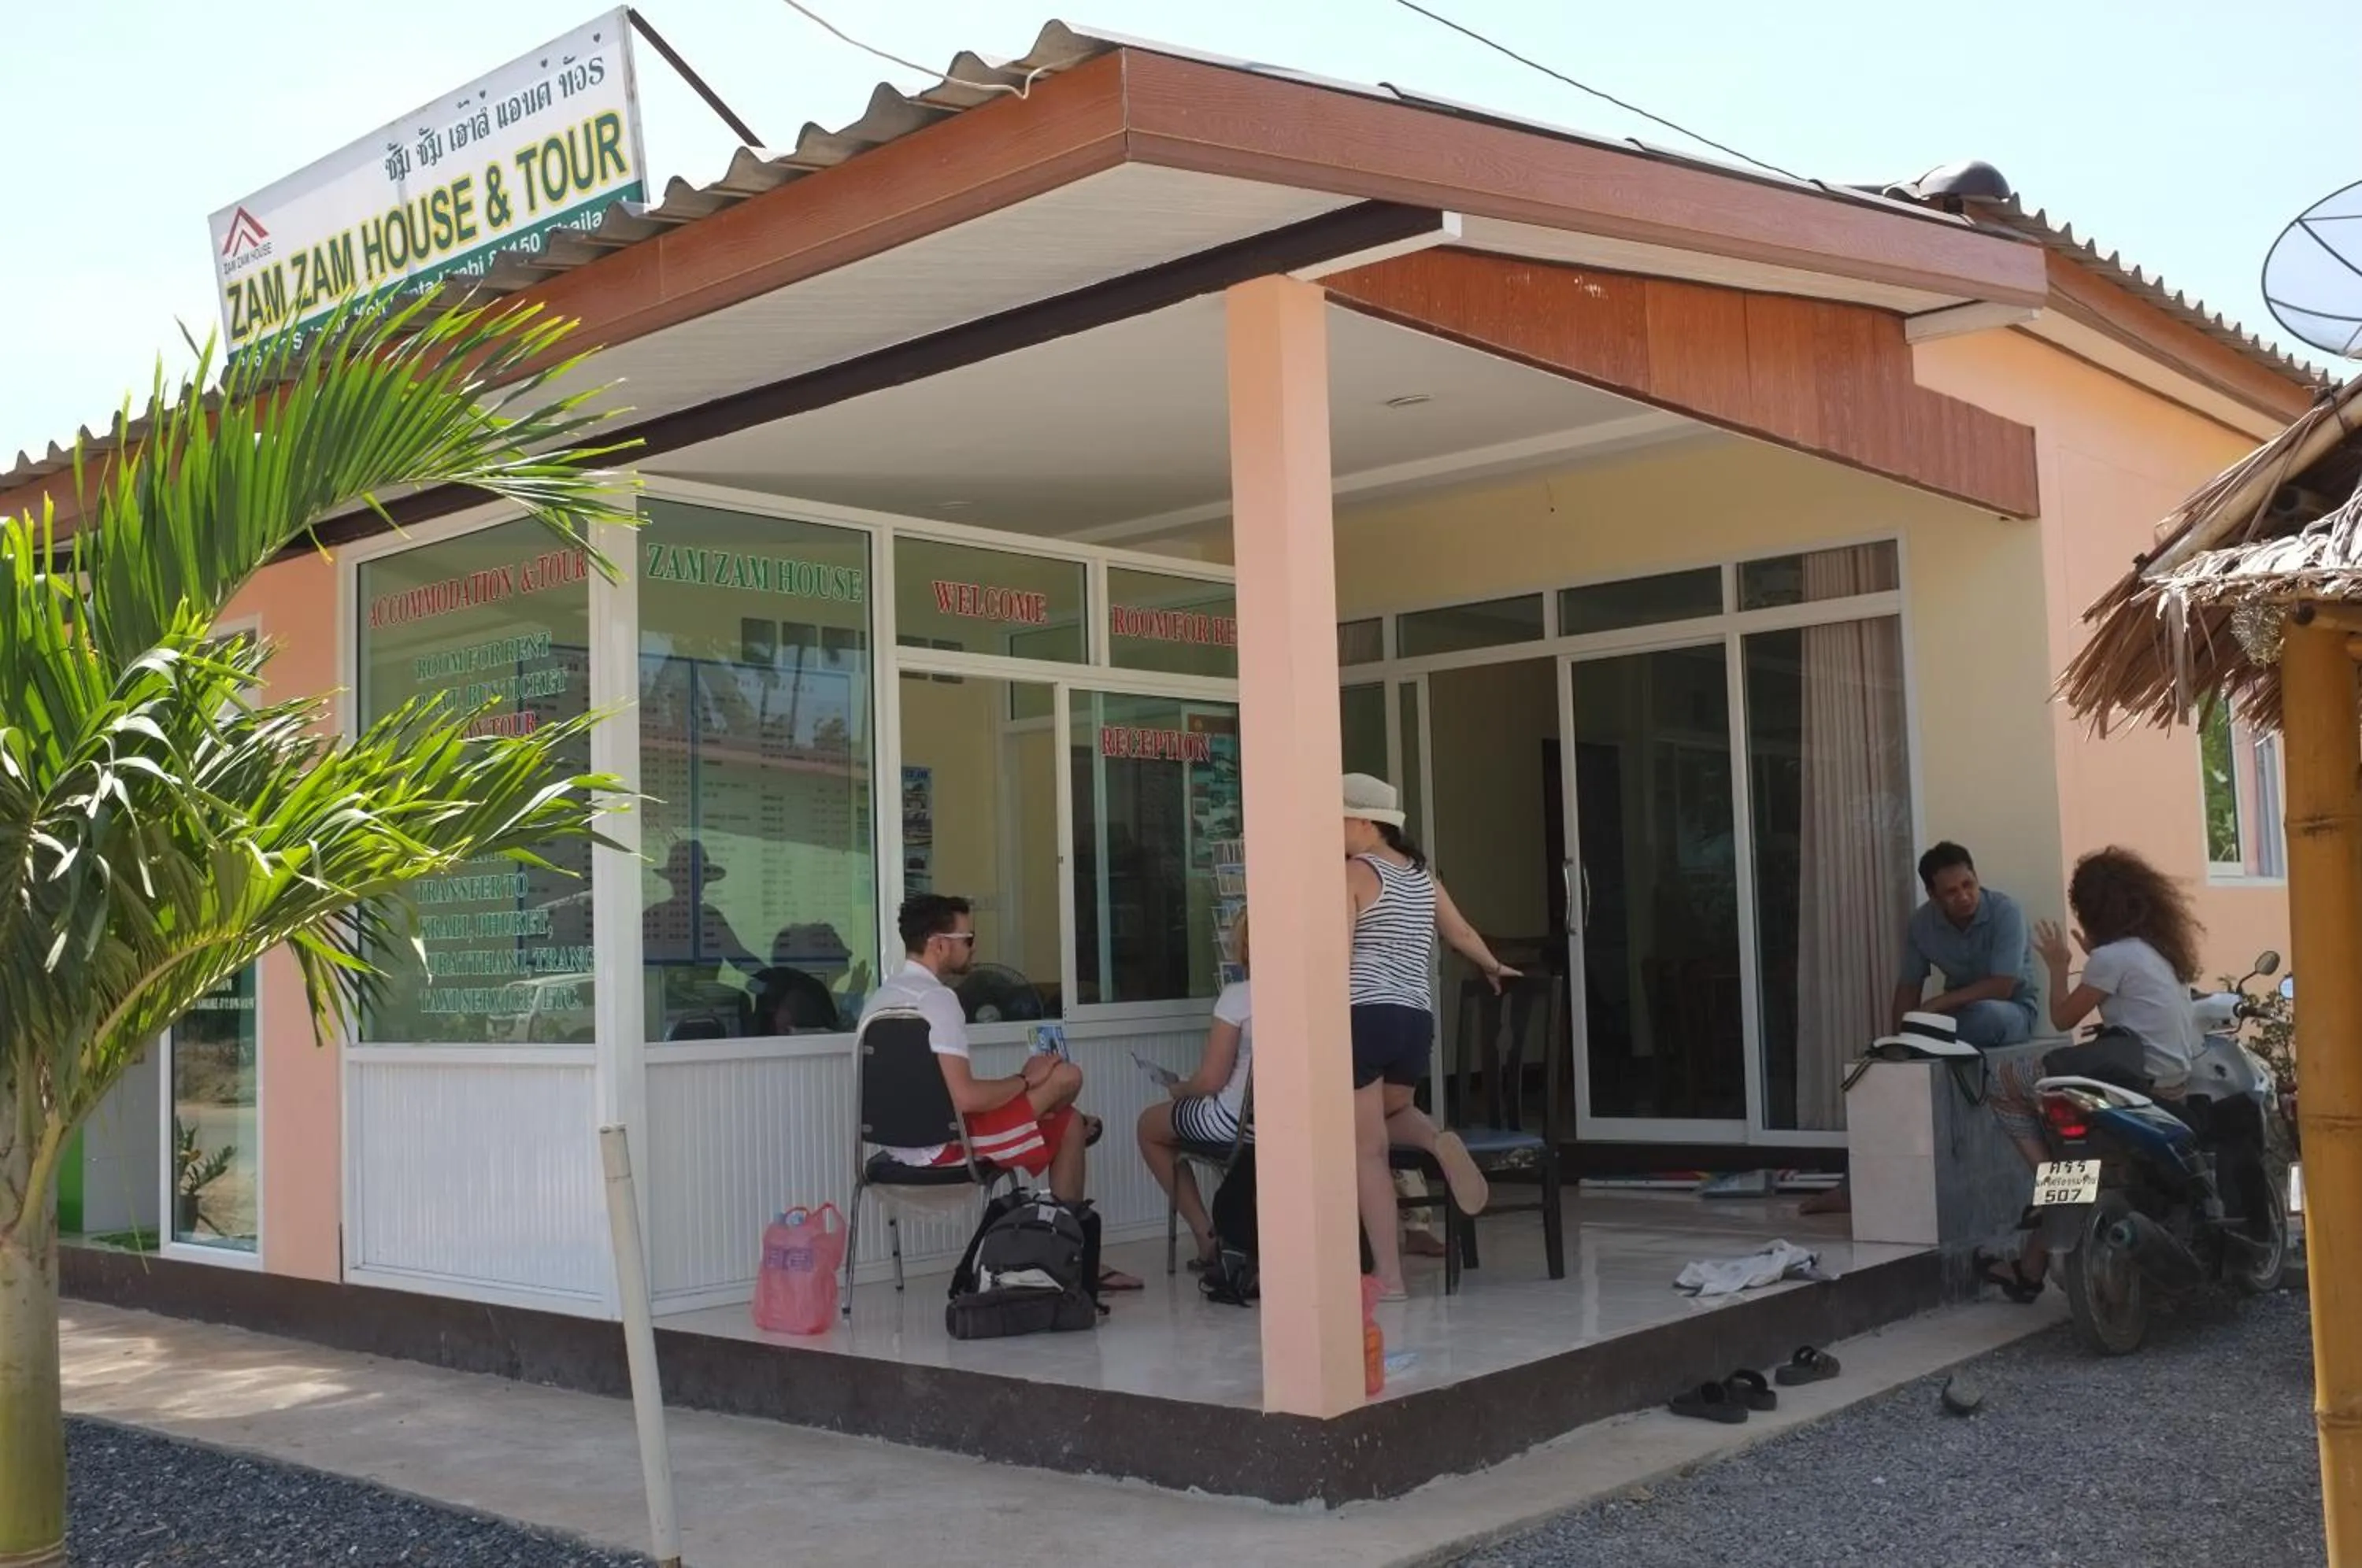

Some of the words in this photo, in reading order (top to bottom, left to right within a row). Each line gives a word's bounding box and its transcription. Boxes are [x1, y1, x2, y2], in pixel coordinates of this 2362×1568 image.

[226, 261, 289, 339] ZAM
[290, 231, 356, 312] ZAM
[360, 175, 477, 283] HOUSE
[484, 163, 512, 228] &
[515, 111, 627, 212] TOUR
[518, 560, 535, 594] &
[535, 548, 588, 589] TOUR
[646, 542, 708, 585] ZAM
[712, 551, 771, 591] ZAM
[775, 558, 862, 603] HOUSE
[932, 580, 1048, 625] WELCOME
[1111, 605, 1171, 640] ROOM
[1172, 612, 1209, 644] FOR
[415, 648, 465, 682] ROOM
[504, 631, 552, 666] RENT
[488, 710, 536, 738] TOUR
[1100, 726, 1212, 761] RECEPTION
[416, 875, 502, 904] TRANSFER
[504, 872, 528, 900] TO
[420, 989, 458, 1013] TAXI
[459, 986, 535, 1012] SERVICE
[2045, 1189, 2082, 1203] 507
